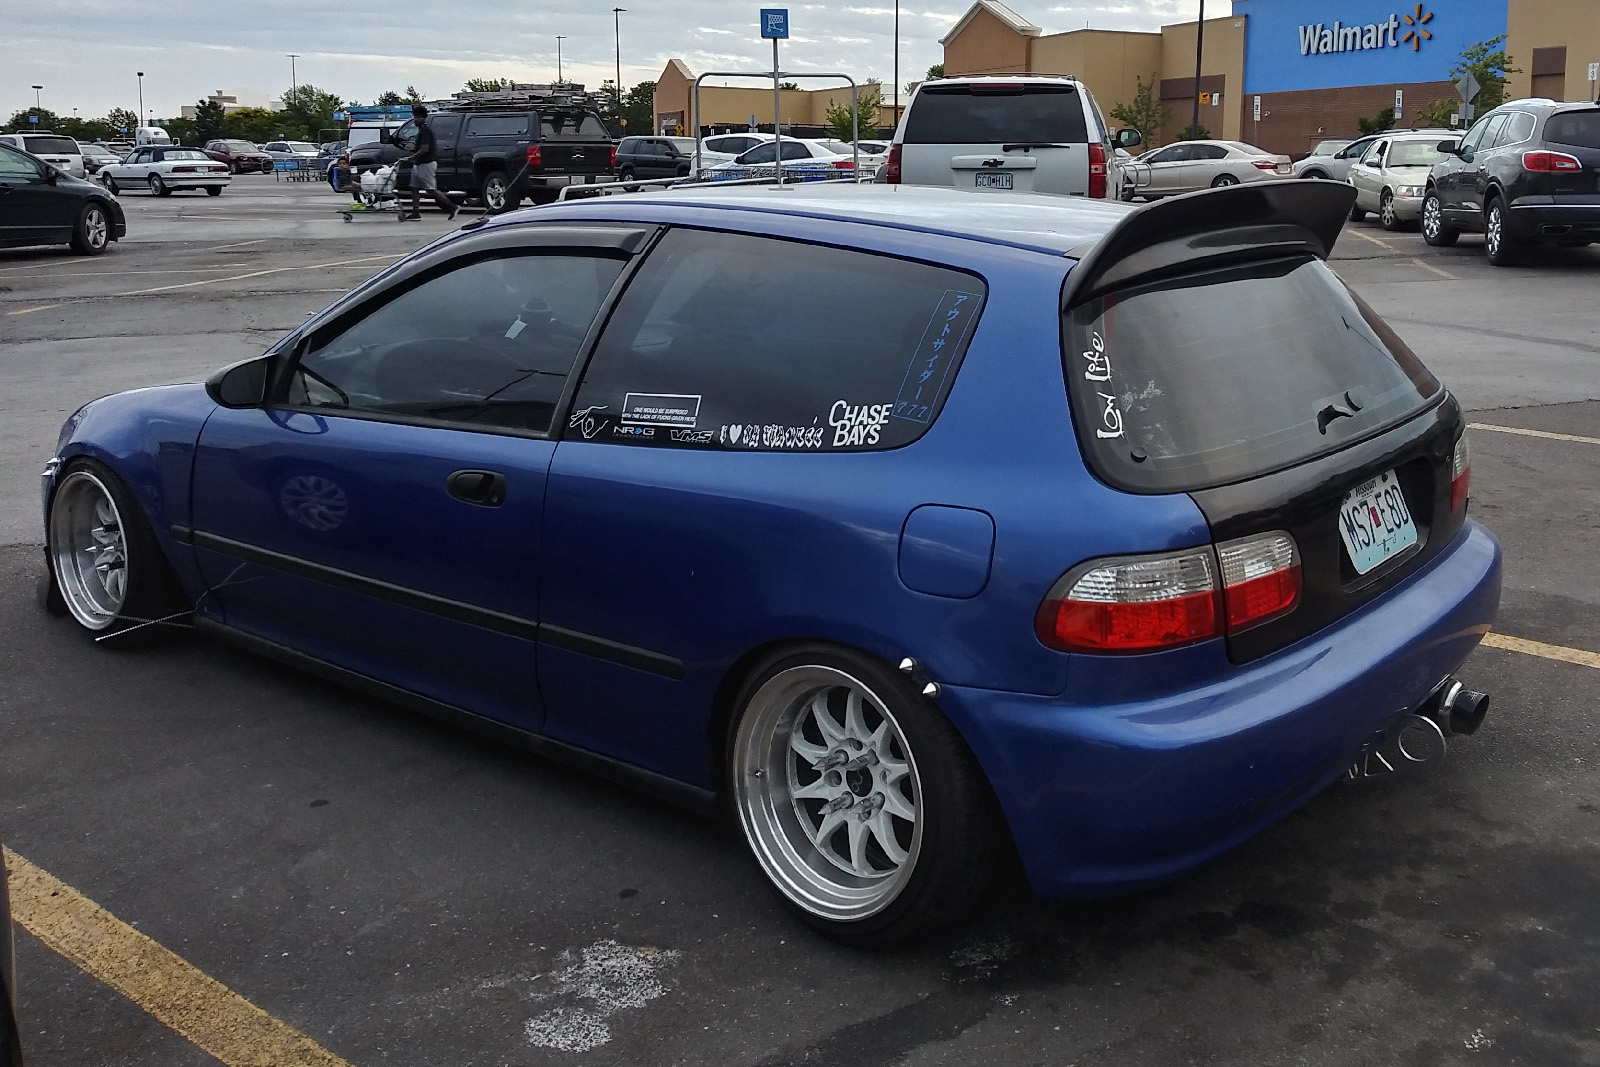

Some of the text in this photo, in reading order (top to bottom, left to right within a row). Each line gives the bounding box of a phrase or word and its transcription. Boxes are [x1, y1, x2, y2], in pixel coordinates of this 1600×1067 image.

[1299, 13, 1399, 56] Walmart
[828, 399, 893, 427] CHASE
[832, 420, 882, 447] BAYS
